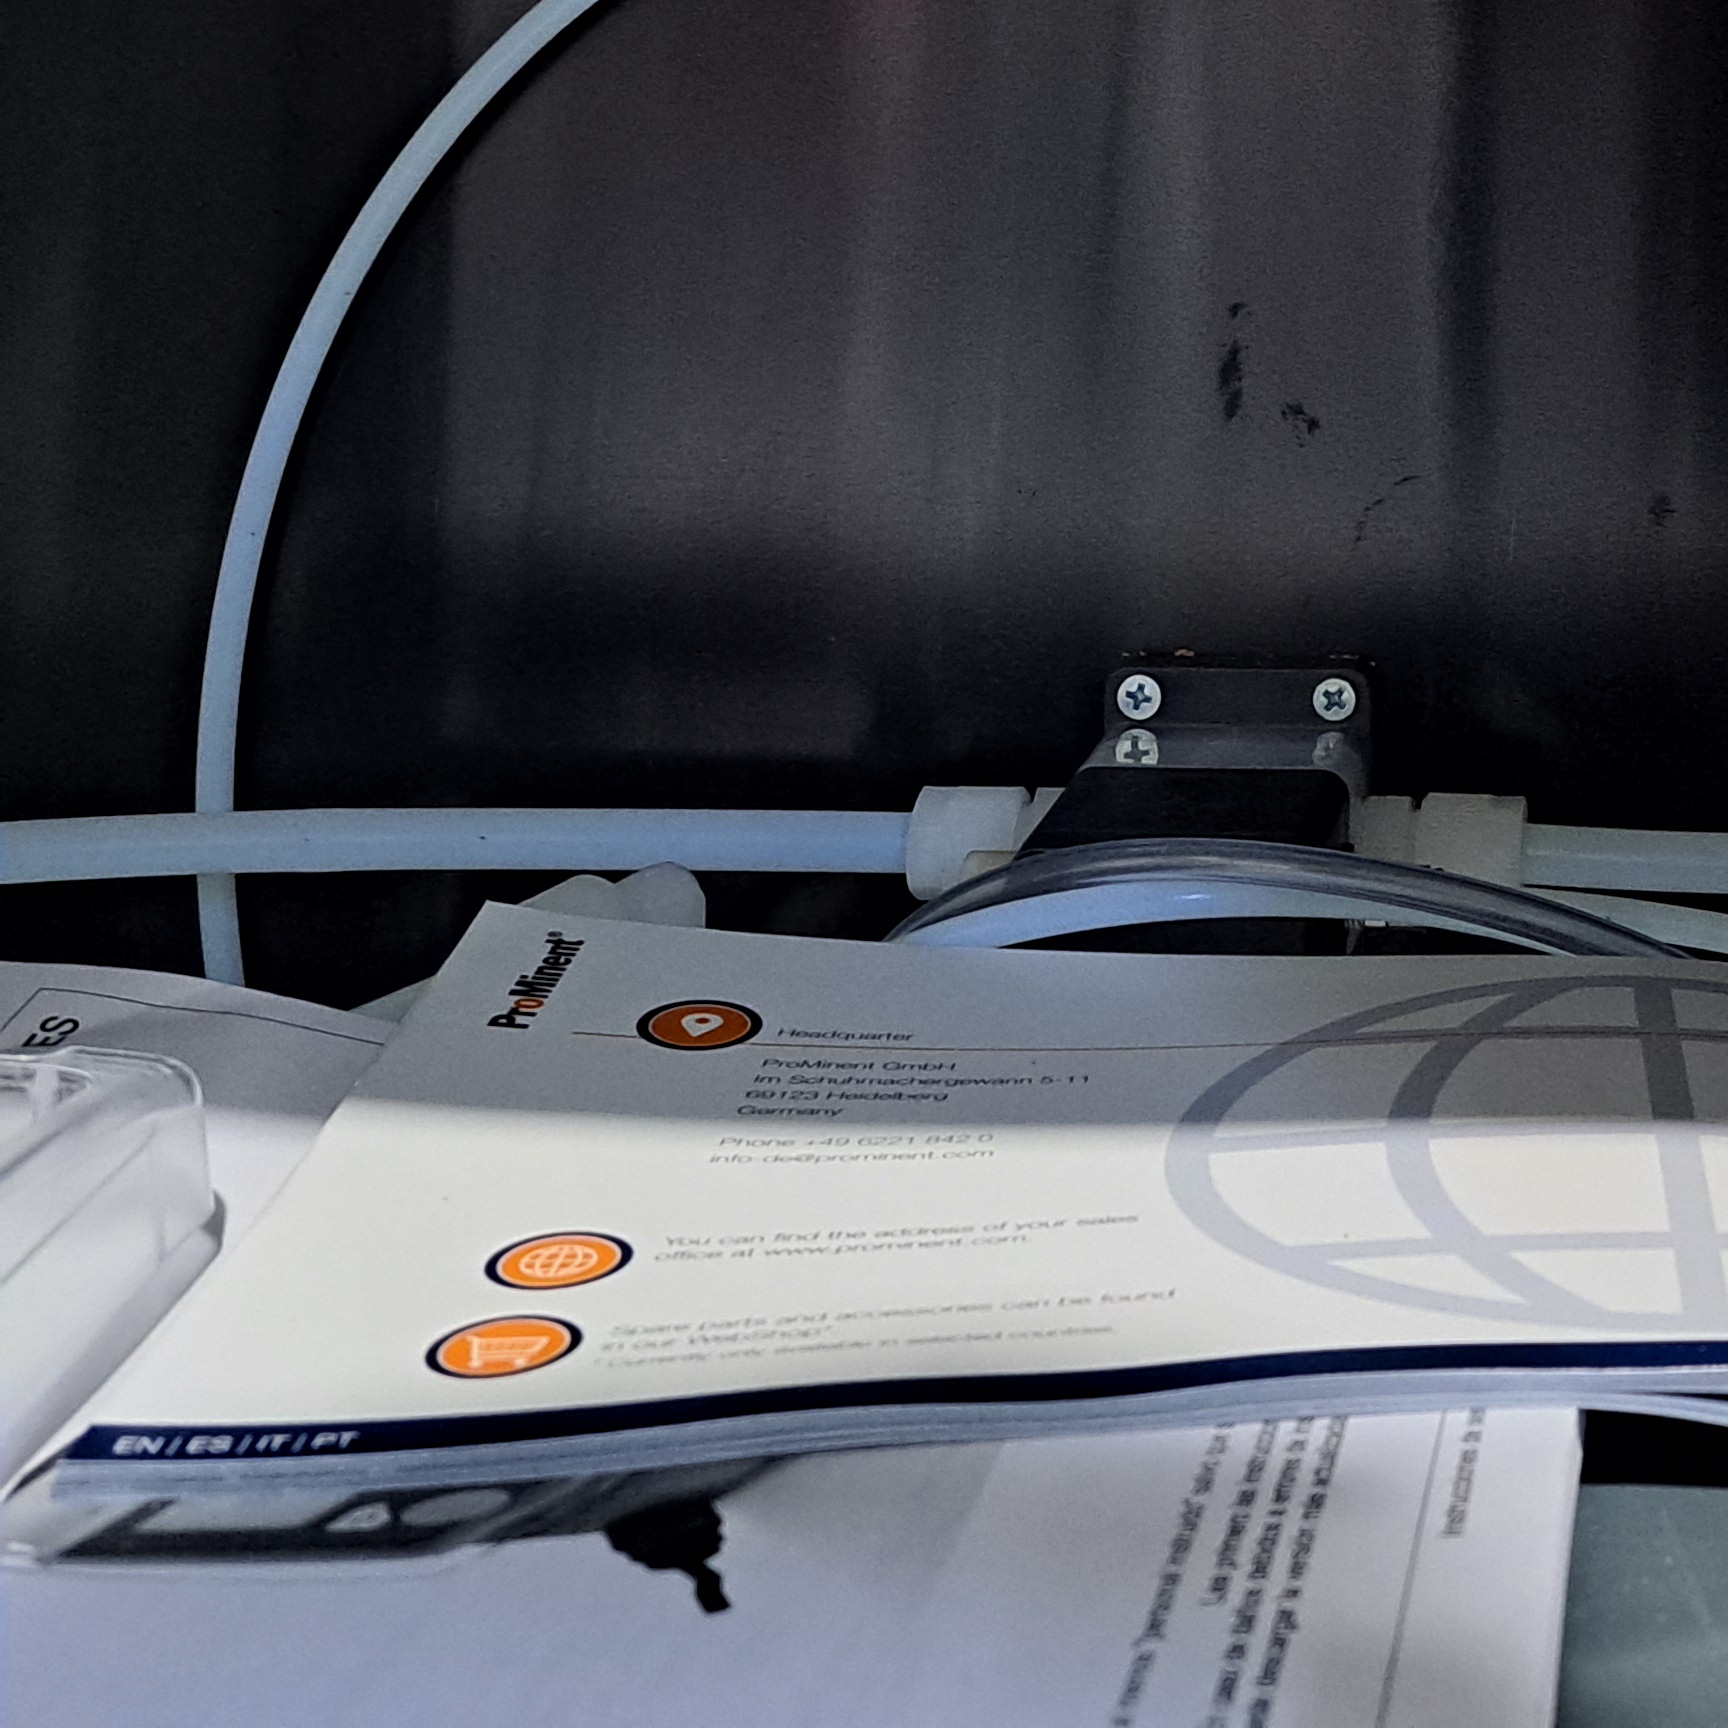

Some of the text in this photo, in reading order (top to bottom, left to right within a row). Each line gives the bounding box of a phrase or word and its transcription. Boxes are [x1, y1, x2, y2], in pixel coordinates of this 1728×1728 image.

[777, 1028, 915, 1042] Headquarter
[761, 1057, 957, 1072] ProMinent GmbH
[788, 1074, 1034, 1087] Schuhmachergewann
[744, 1089, 949, 1103] 69123 Heidelberg
[736, 1104, 844, 1118] Germany
[719, 1136, 796, 1148] Phone
[857, 1135, 916, 1147] 6221
[664, 1234, 711, 1247] You
[718, 1234, 766, 1245] can
[772, 1230, 820, 1243] find
[827, 1229, 867, 1241] the
[873, 1224, 976, 1238] address
[981, 1221, 1008, 1233] of
[1014, 1218, 1068, 1232] your
[653, 1249, 724, 1263] office
[730, 1248, 756, 1259] at
